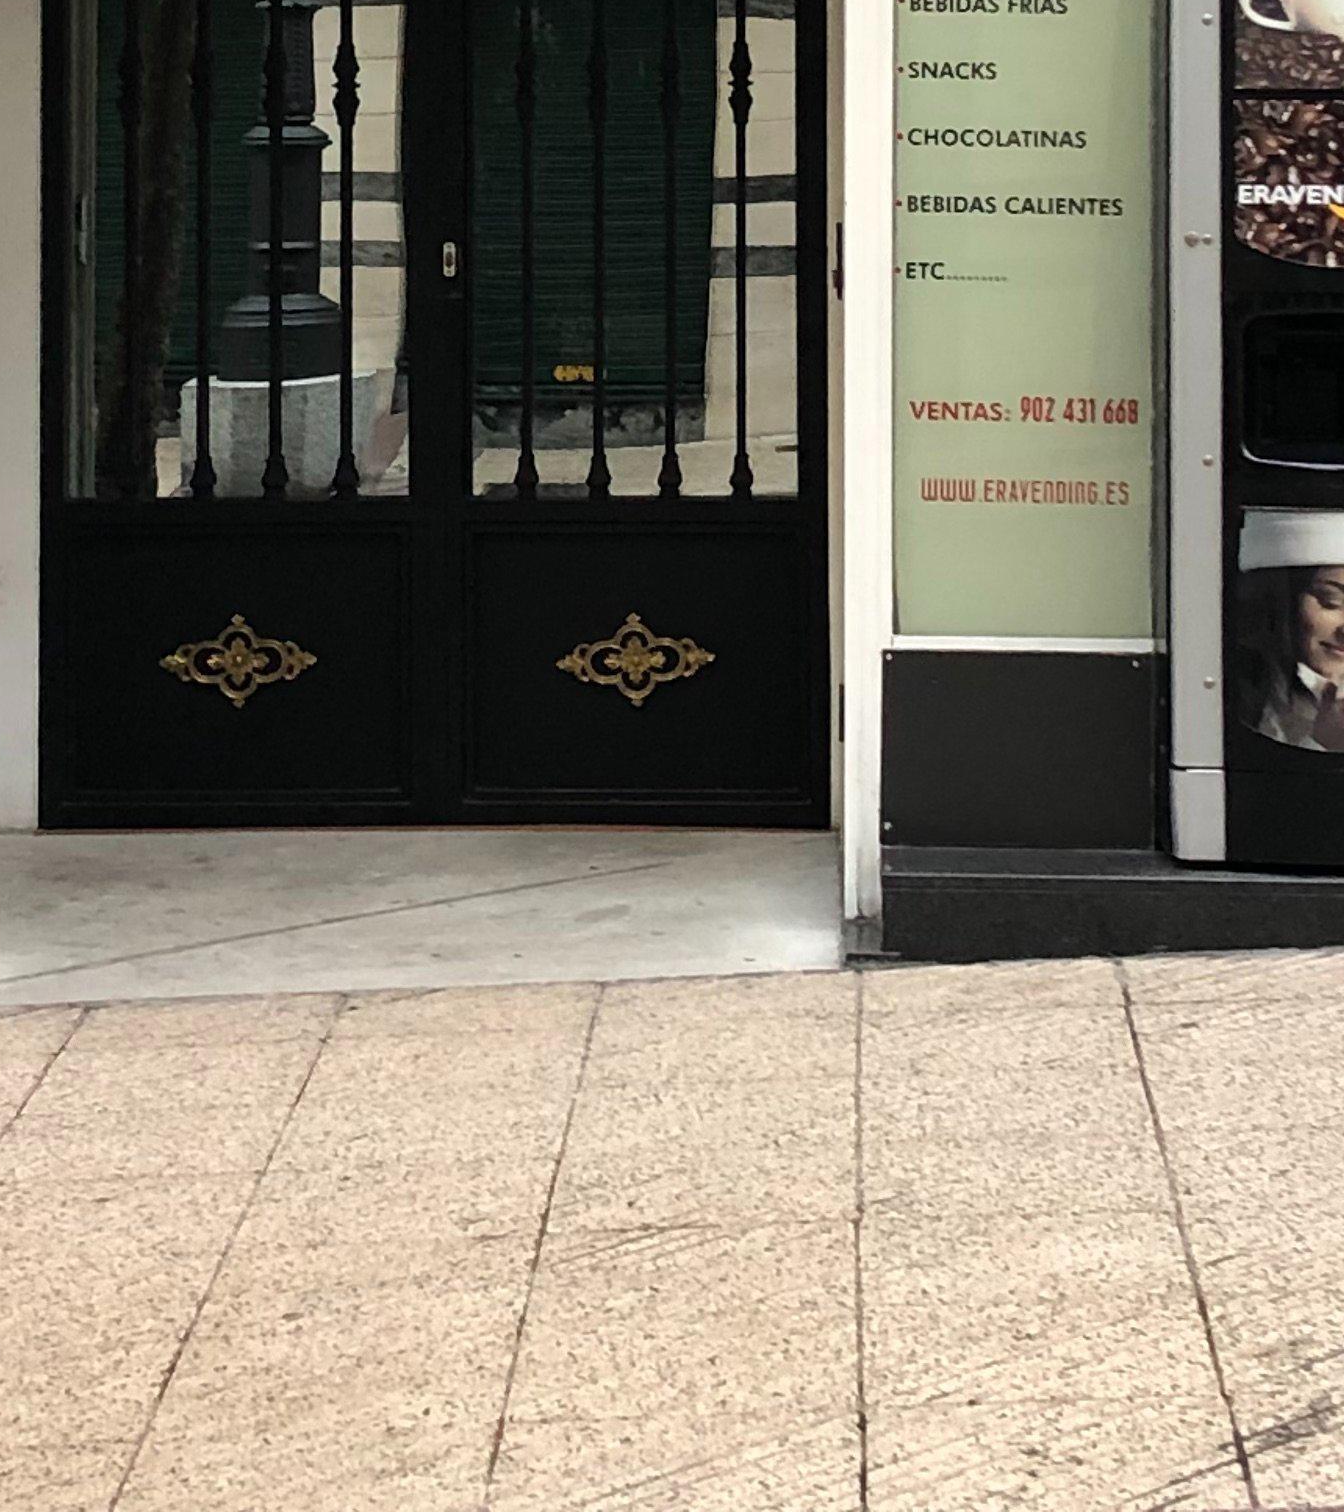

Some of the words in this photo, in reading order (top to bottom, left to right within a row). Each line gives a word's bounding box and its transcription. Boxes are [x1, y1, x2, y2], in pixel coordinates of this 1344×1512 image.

[908, 62, 998, 81] SNACKS
[908, 128, 1087, 149] CHOCOLATINAS
[908, 195, 997, 215] BEBIDAS
[1005, 197, 1124, 217] CALIENTES
[909, 400, 1011, 423] VENTAS:
[1020, 396, 1057, 423] 902
[1063, 397, 1096, 424] 431
[1103, 398, 1139, 425] 668
